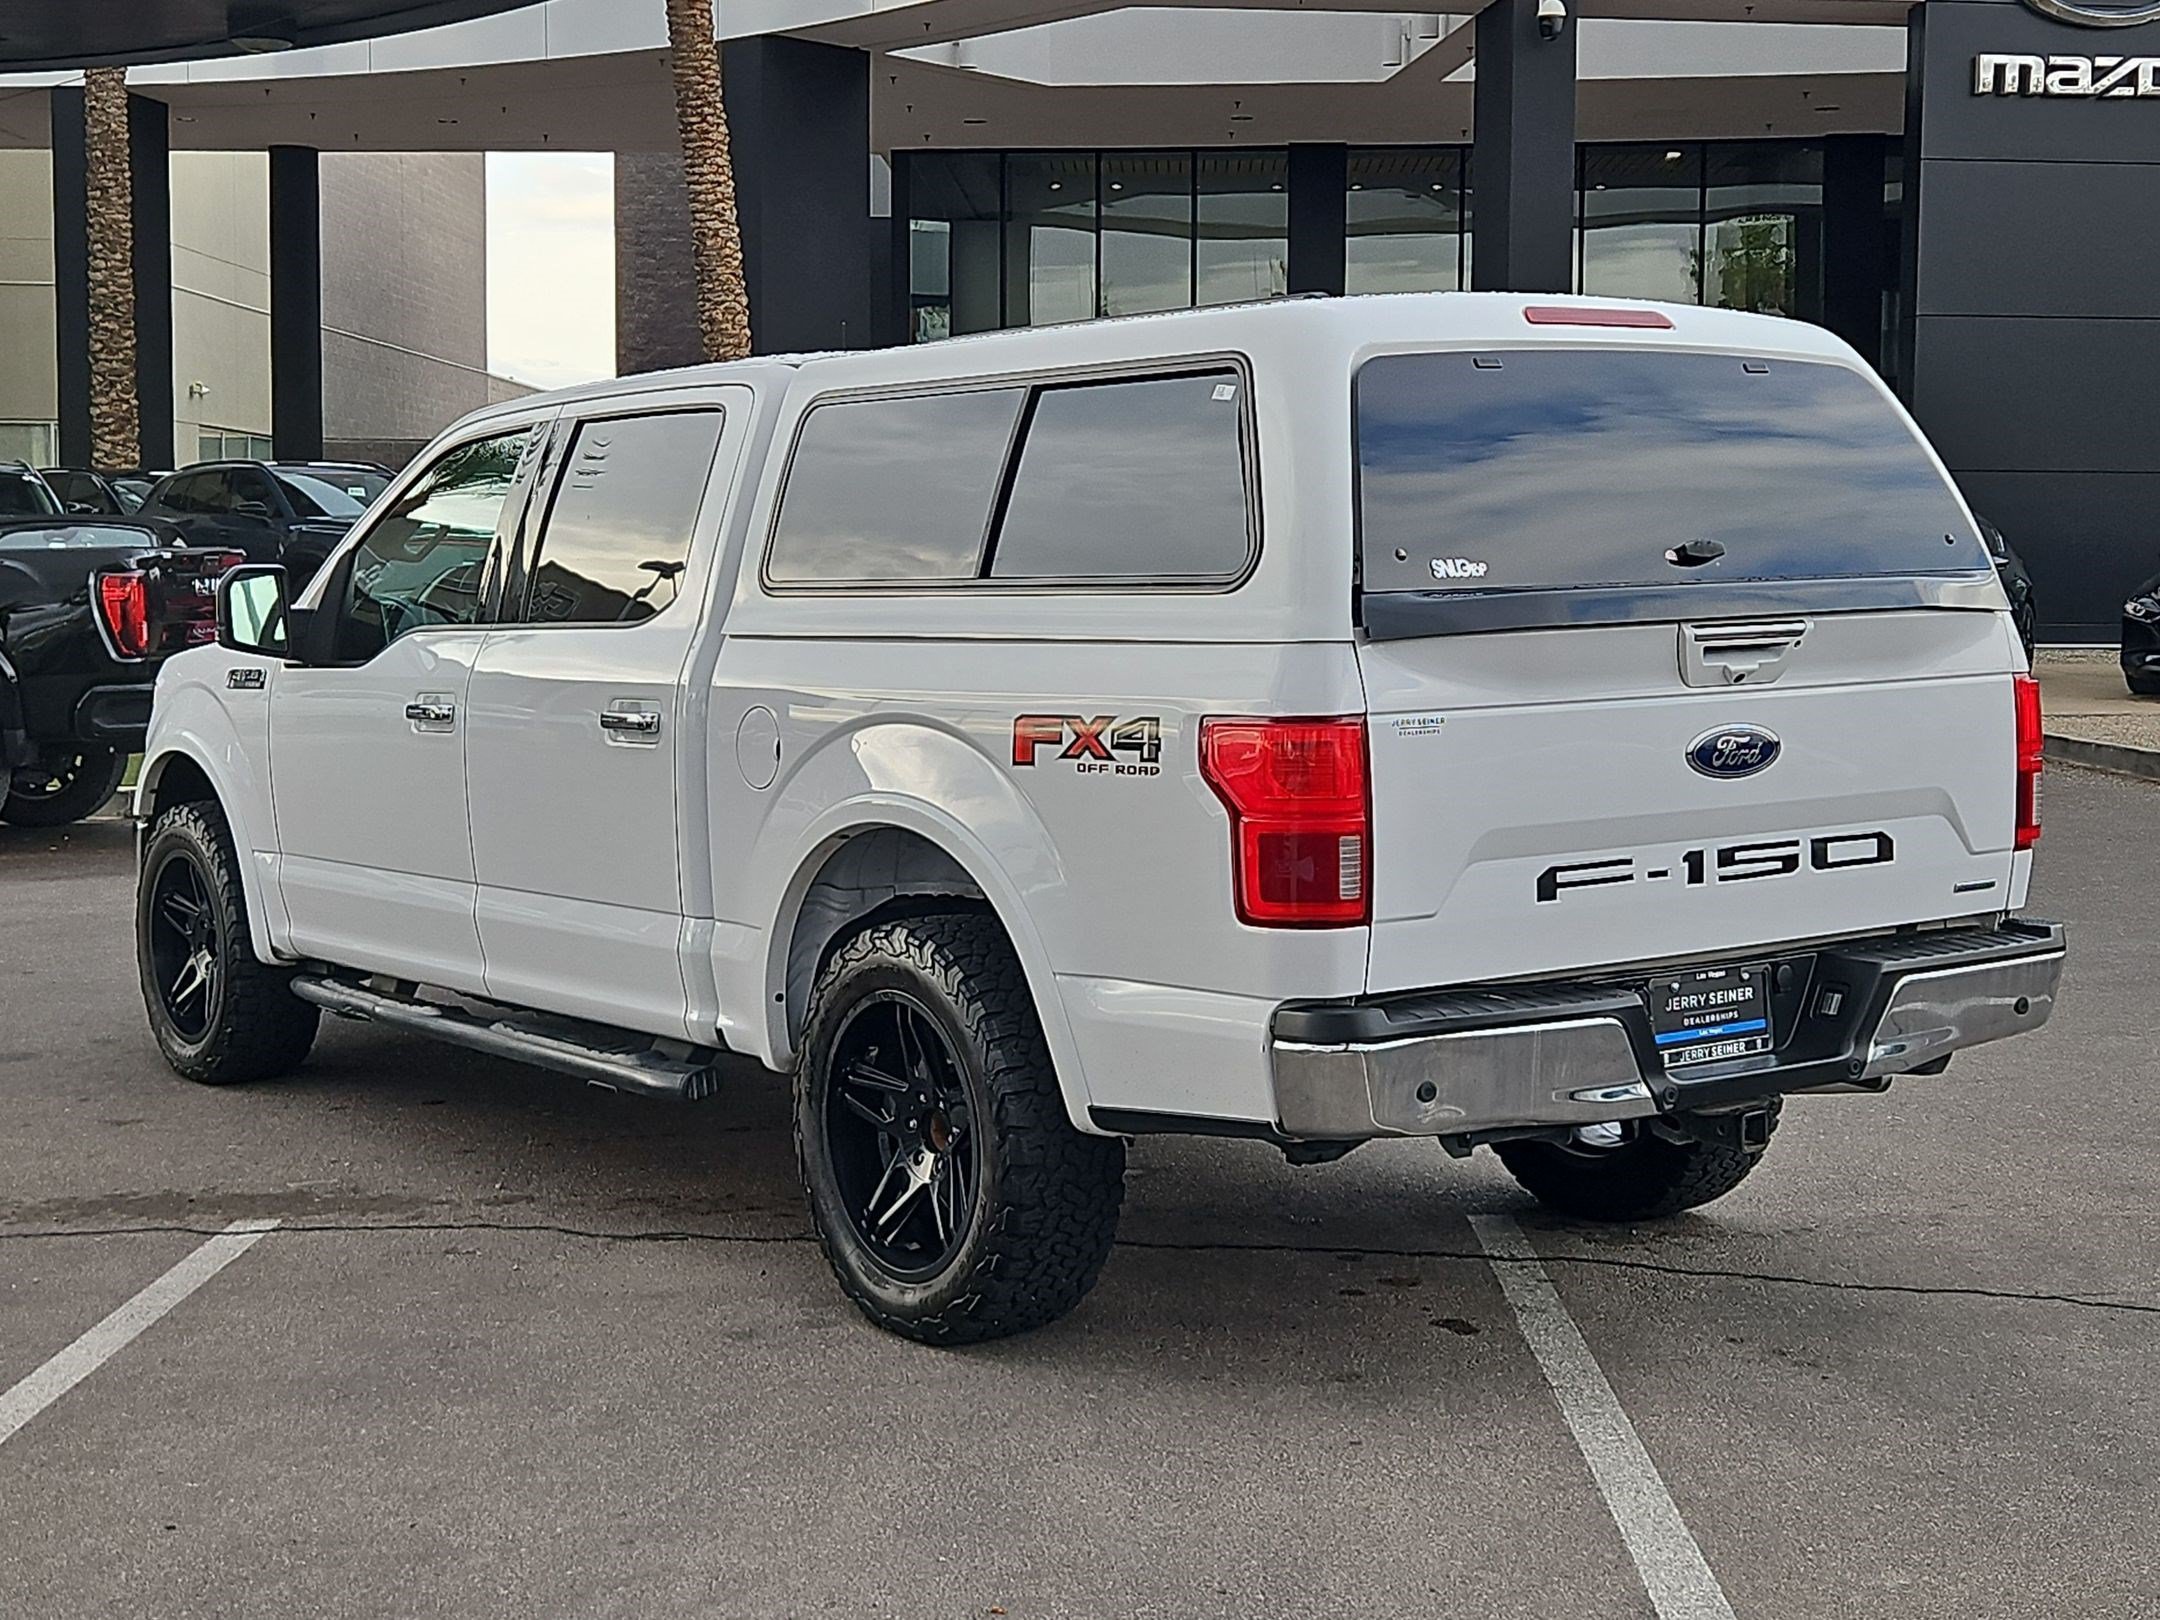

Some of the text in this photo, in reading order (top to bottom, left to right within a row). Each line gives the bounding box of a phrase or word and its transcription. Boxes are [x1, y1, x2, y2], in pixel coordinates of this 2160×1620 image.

[1012, 714, 1161, 766] FX4
[1712, 735, 1763, 767] Ford
[1077, 763, 1161, 776] OFF ROAD
[1535, 830, 1895, 903] F-150
[1695, 970, 1726, 980] Las Vegas
[1665, 987, 1754, 1012] JERRY SEINER
[1683, 1010, 1739, 1026] DEALERSHIPS
[1680, 1048, 1710, 1062] JERRY
